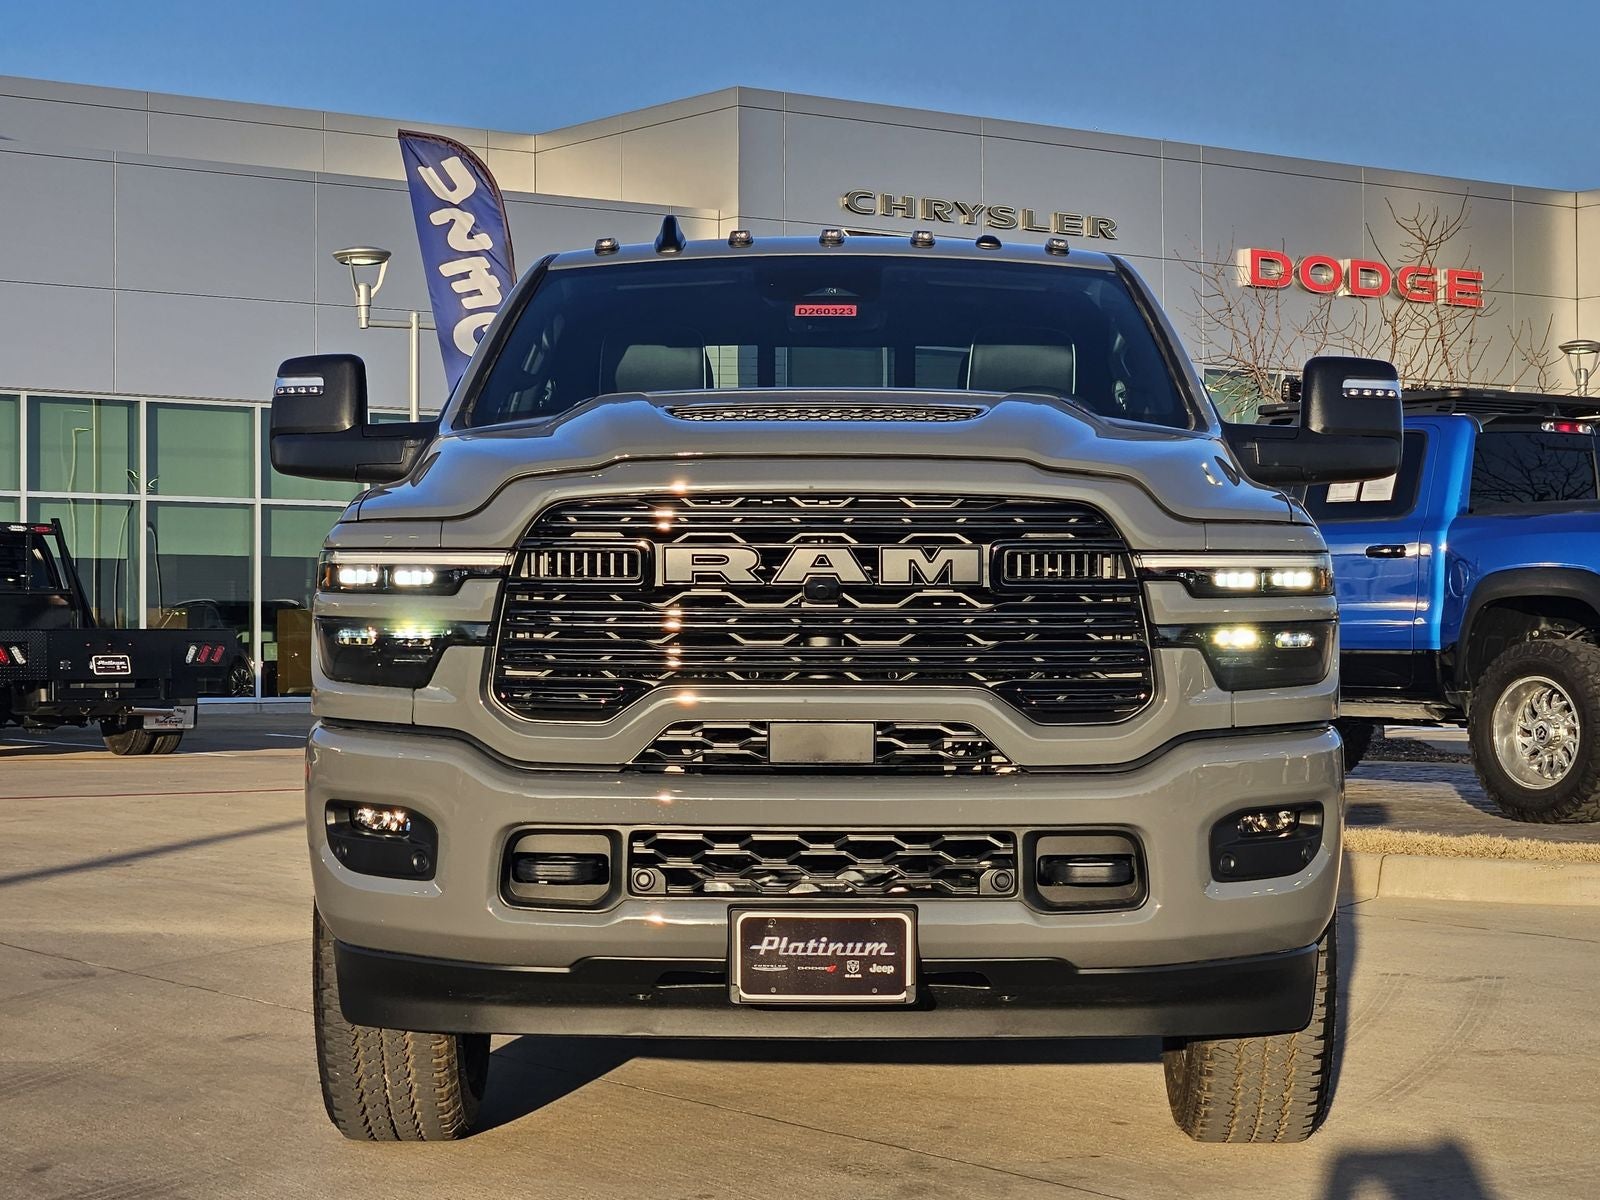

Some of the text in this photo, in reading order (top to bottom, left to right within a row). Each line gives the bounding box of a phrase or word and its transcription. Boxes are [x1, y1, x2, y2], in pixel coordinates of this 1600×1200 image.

[841, 190, 1118, 240] CHRYSLER
[1240, 248, 1485, 308] DODGE
[798, 307, 854, 316] D260323
[662, 544, 983, 586] RAM
[750, 936, 896, 956] Platinum
[869, 963, 895, 975] Jeep
